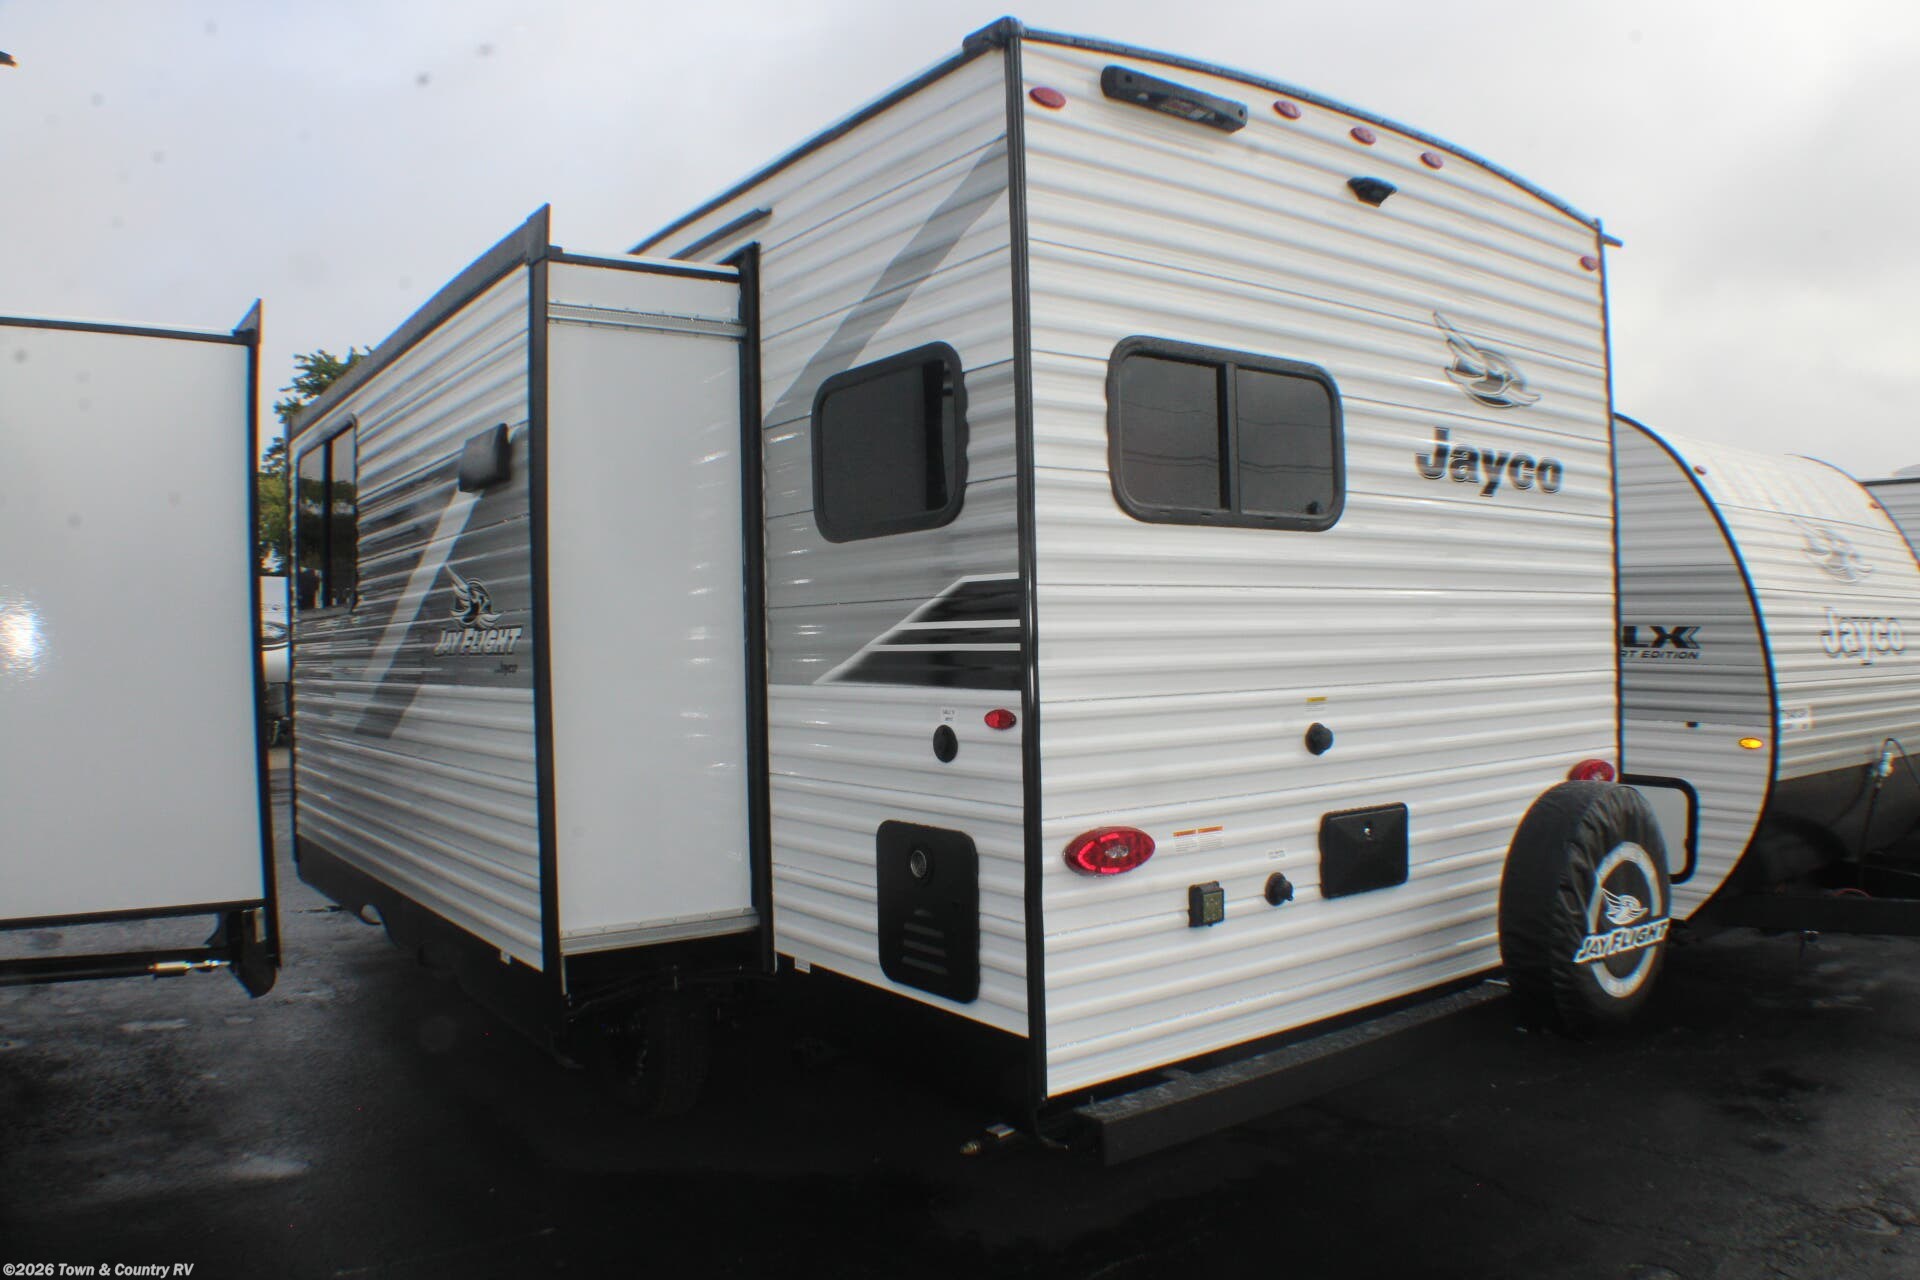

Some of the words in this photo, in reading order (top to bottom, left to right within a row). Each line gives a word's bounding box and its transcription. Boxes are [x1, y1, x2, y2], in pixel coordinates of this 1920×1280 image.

[1415, 426, 1563, 497] Jayco
[433, 629, 463, 656] JAY
[459, 625, 523, 655] FLIGHT
[1640, 650, 1700, 659] EDITION
[1820, 606, 1905, 666] Jayco
[1574, 934, 1610, 962] JAY
[1608, 918, 1670, 954] FLIGHT
